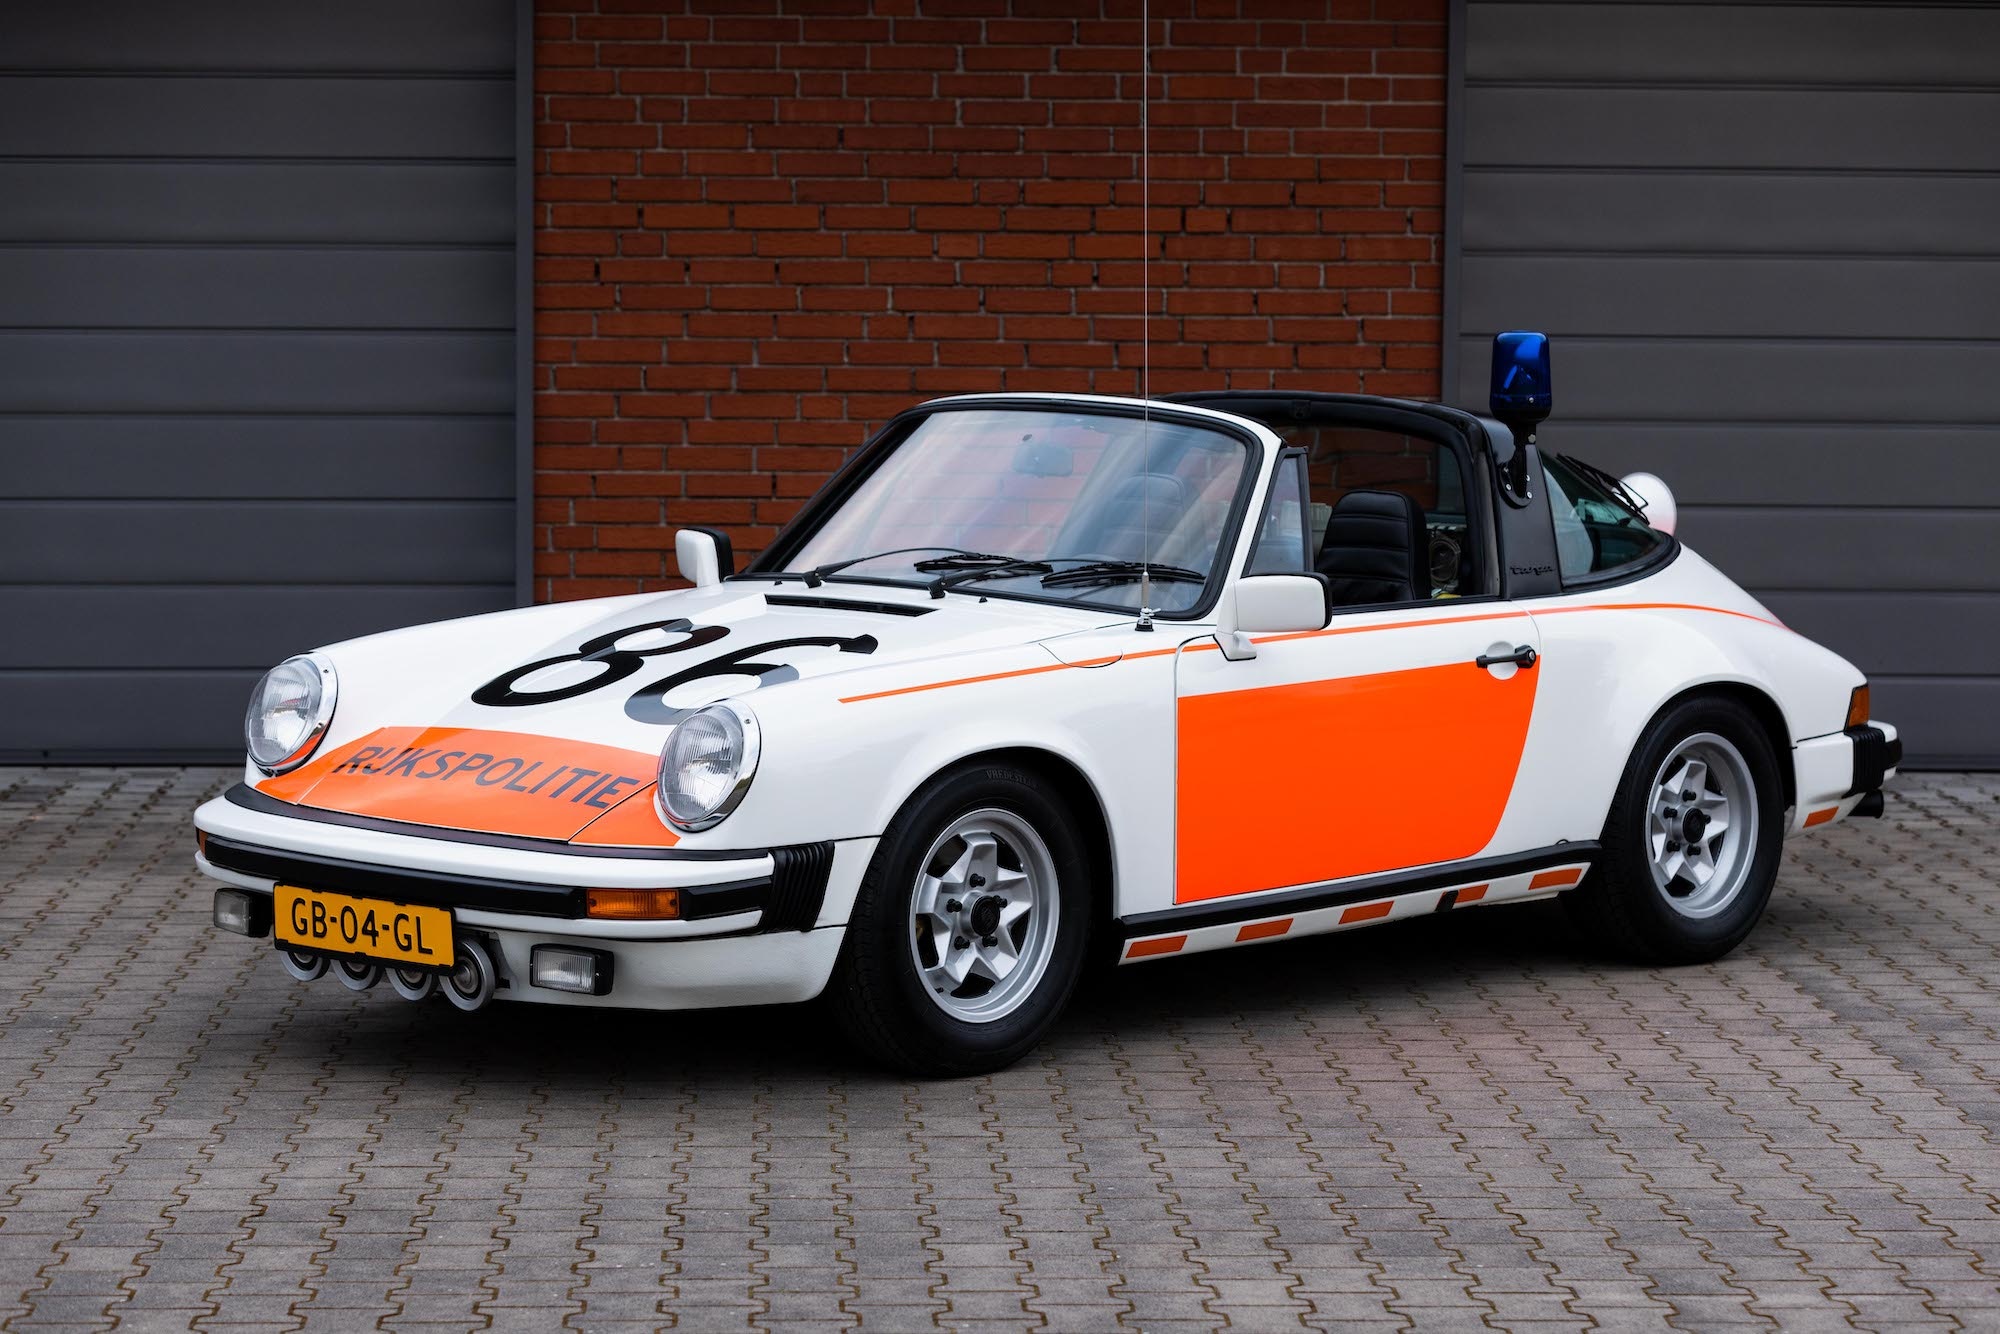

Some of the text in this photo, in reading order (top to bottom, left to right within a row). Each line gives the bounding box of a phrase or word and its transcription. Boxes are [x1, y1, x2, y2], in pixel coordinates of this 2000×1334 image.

[471, 618, 878, 725] 86
[332, 746, 640, 808] RIJKSPOLITIE
[291, 898, 433, 955] GB-04-GL
